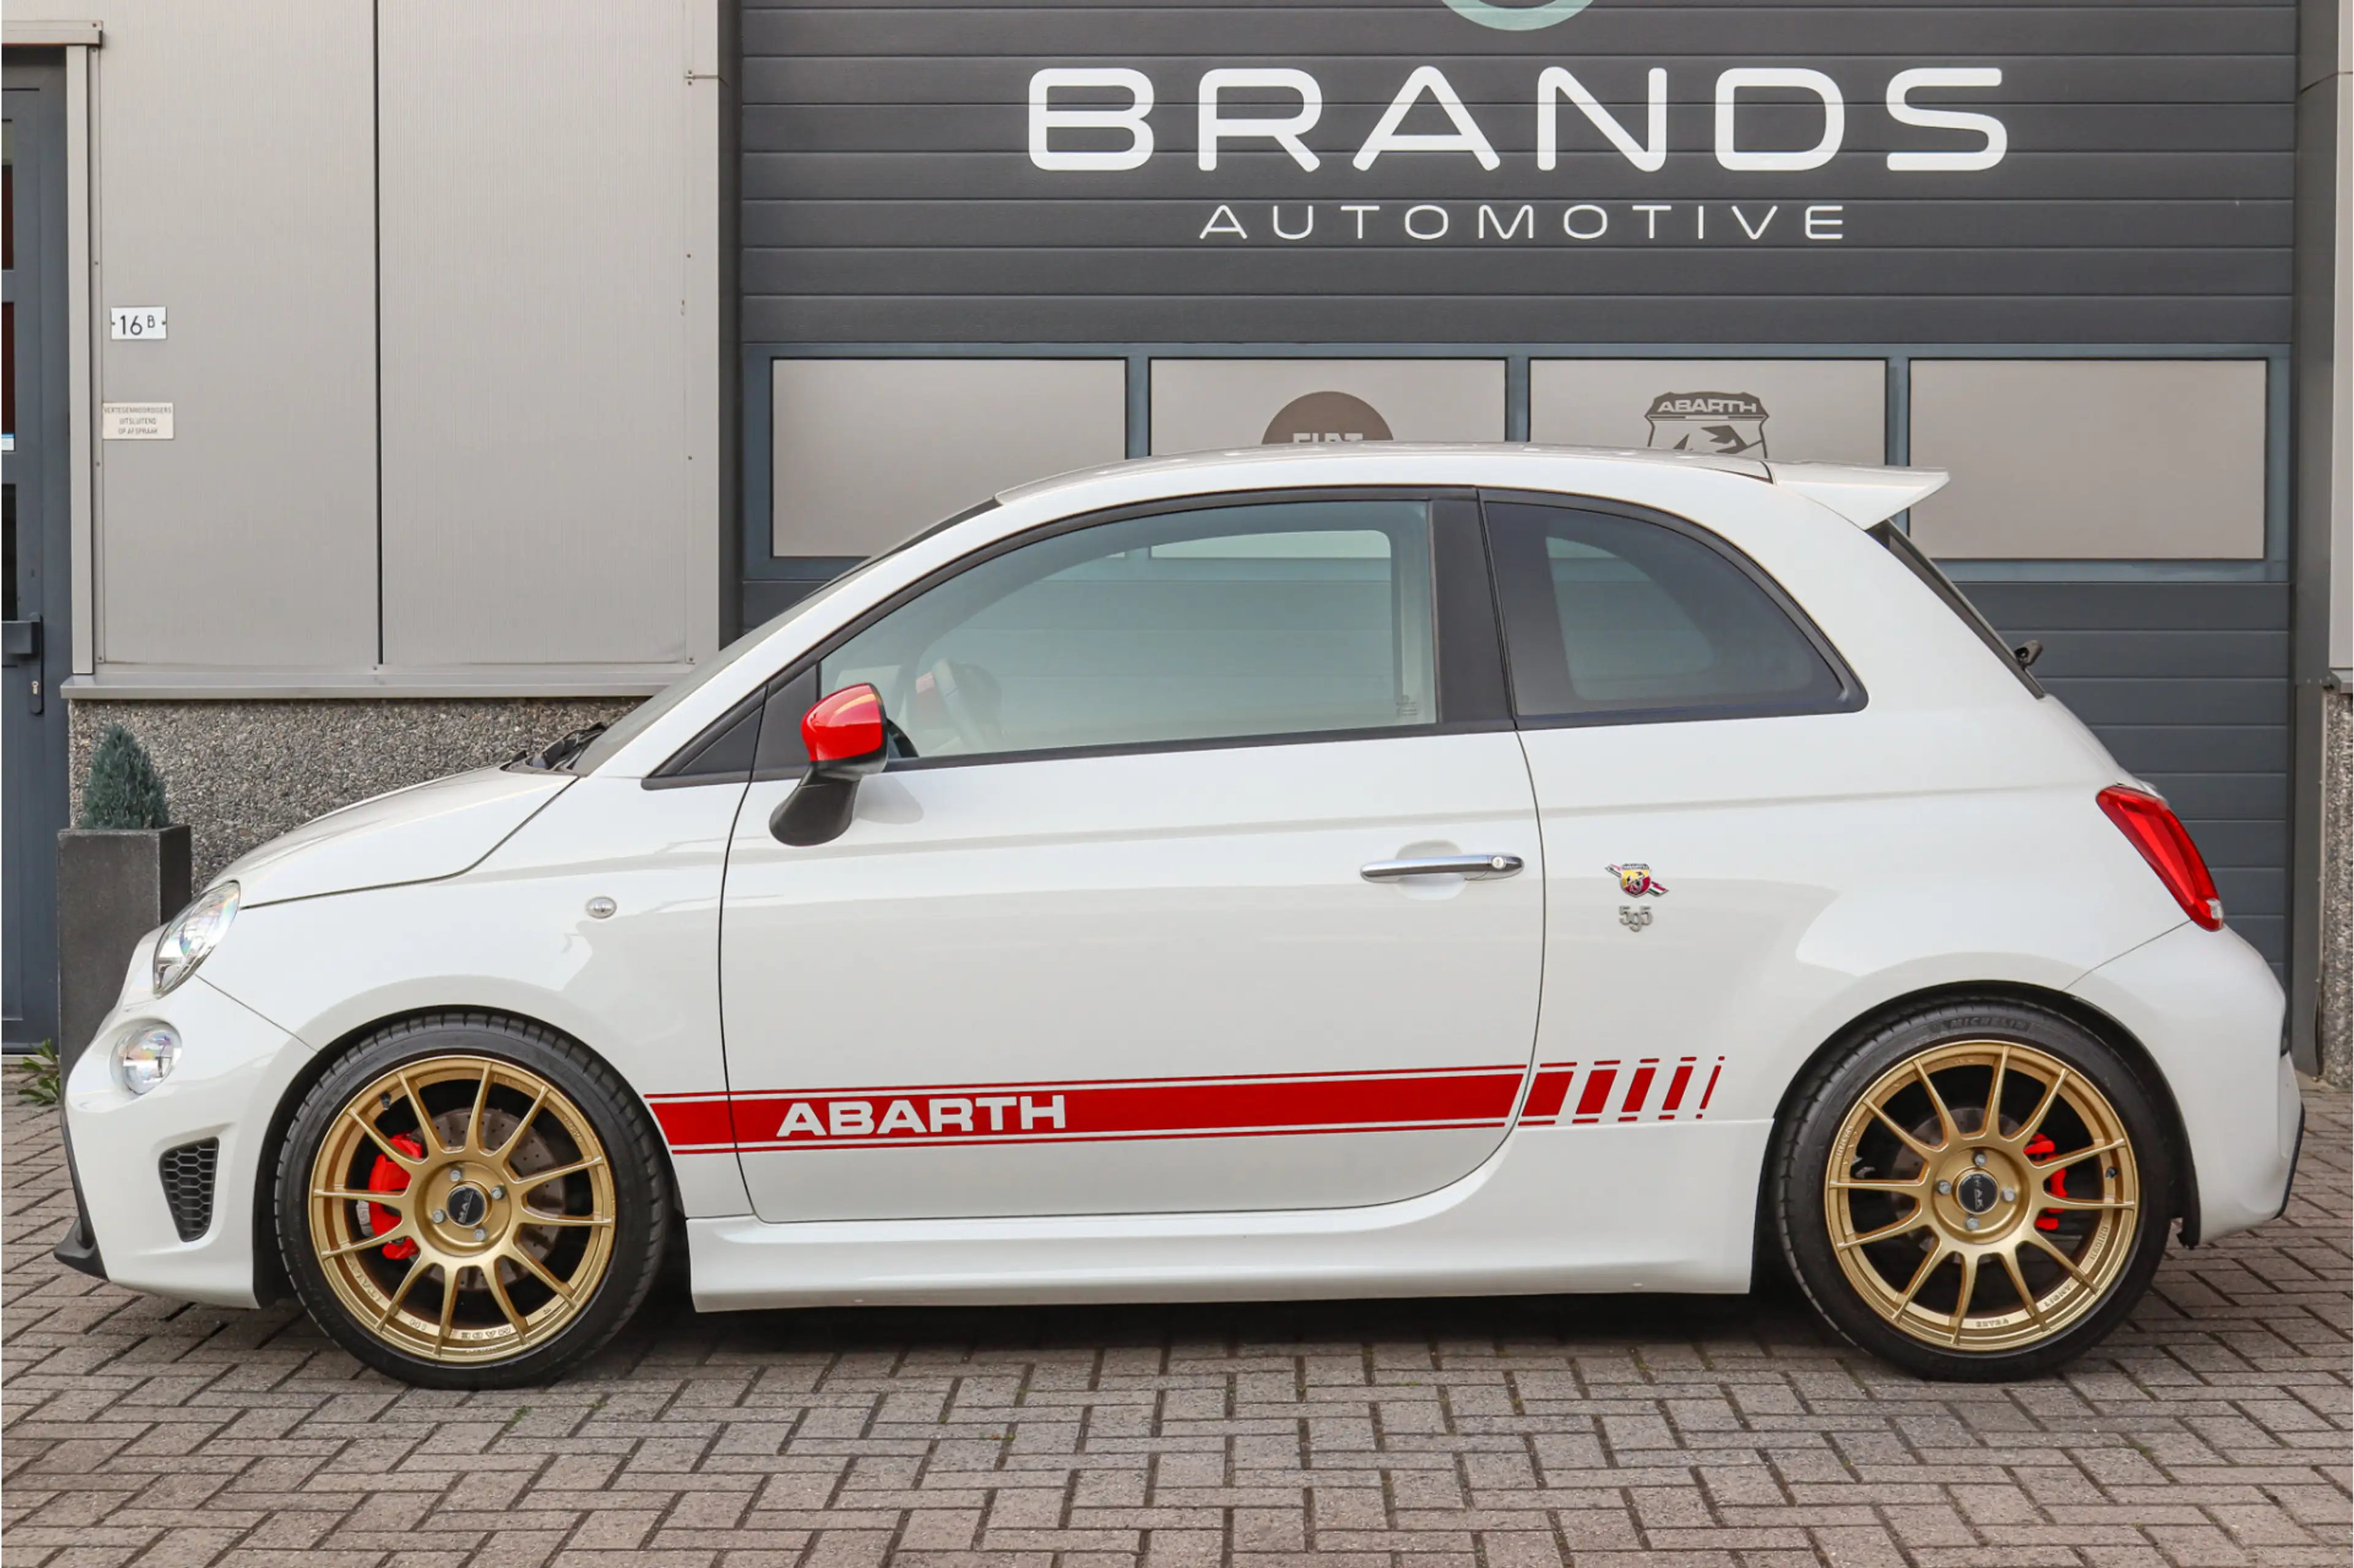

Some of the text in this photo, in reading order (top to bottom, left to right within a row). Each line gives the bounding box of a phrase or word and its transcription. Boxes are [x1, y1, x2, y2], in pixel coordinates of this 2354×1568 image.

[1029, 66, 2008, 172] BRANDS
[1199, 204, 1843, 240] AUTOMOTIVE
[1657, 398, 1757, 413] ABARTH
[1618, 905, 1653, 932] 595
[776, 1095, 1066, 1137] ABARTH
[461, 1326, 511, 1339] MADE
